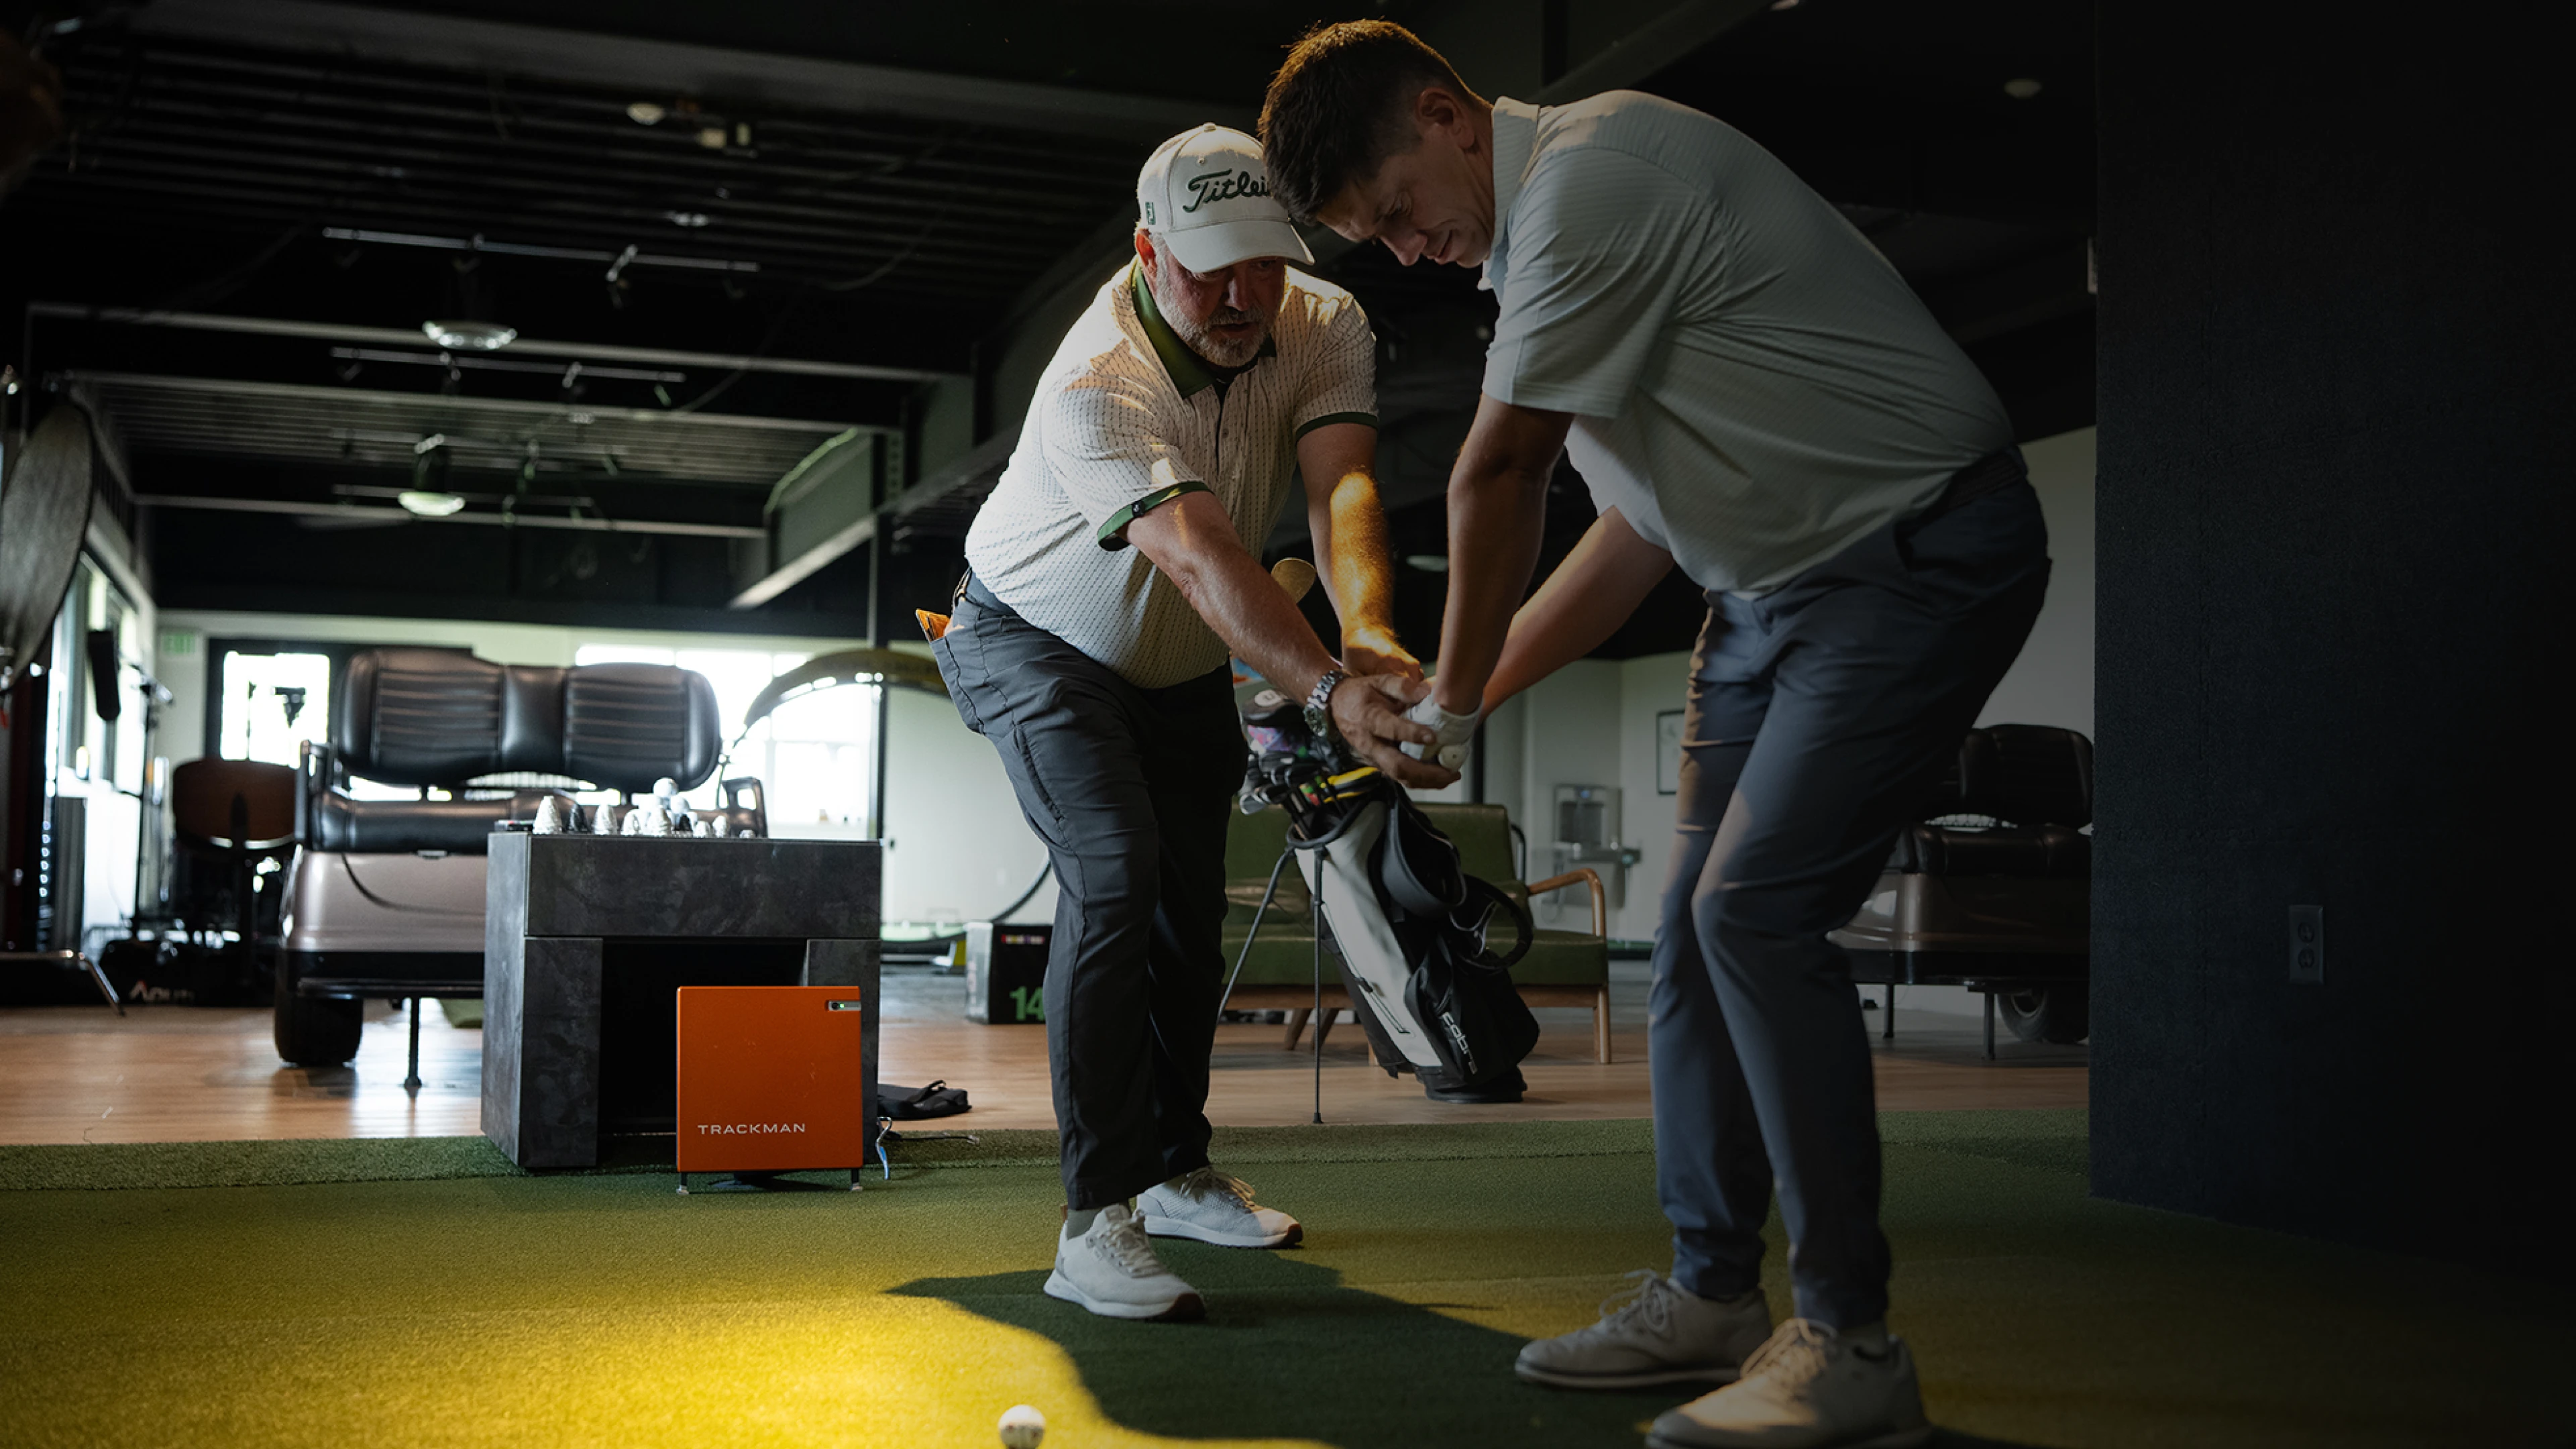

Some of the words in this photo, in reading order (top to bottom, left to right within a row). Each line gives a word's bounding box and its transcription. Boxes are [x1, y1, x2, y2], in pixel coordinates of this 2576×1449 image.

[1183, 168, 1270, 213] Titlei
[1009, 985, 1044, 1020] 14
[698, 1124, 806, 1134] TRACKMAN
